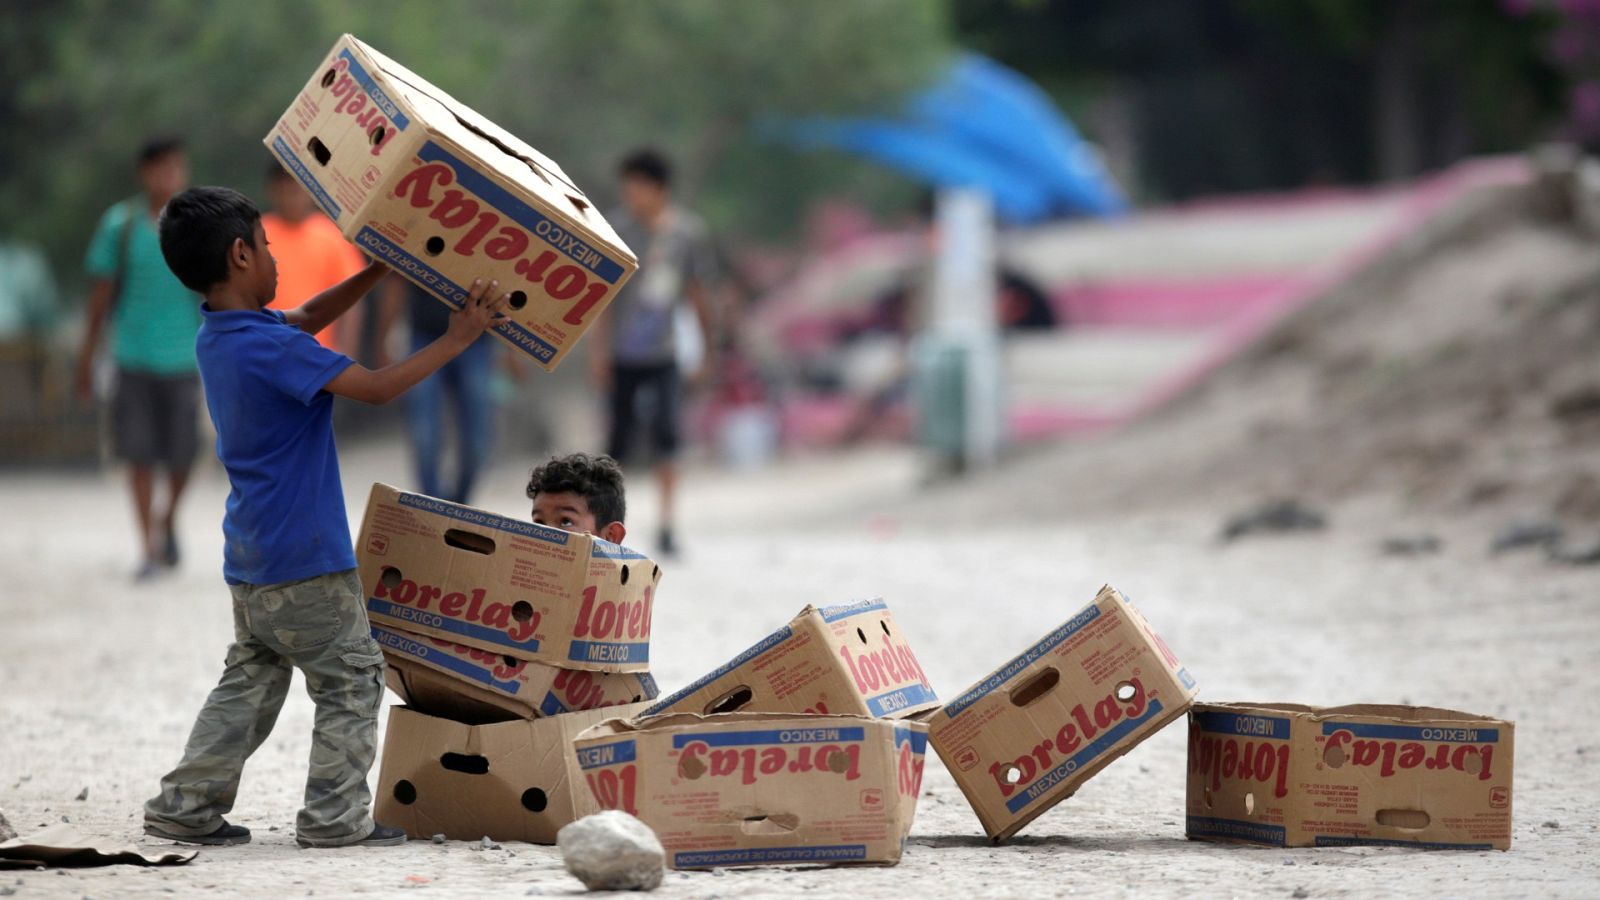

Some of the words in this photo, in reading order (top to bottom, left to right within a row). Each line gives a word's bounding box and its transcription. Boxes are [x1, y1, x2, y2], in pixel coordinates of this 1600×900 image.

[369, 86, 398, 120] MEXICO
[358, 228, 439, 286] EXPORTACION
[394, 164, 609, 326] lorelay
[532, 216, 604, 269] MEXICO
[434, 279, 456, 297] DE
[499, 321, 553, 360] BANANAS
[399, 492, 445, 513] BANANAS
[445, 504, 486, 524] CALIDAD
[486, 515, 501, 527] DE
[500, 518, 567, 544] EXPORTACION
[389, 604, 443, 628] MEXICO
[573, 583, 651, 640] lorel
[376, 631, 429, 658] MEXICO
[588, 644, 629, 661] MEXICO
[839, 633, 929, 696] lorelay
[947, 681, 990, 718] BANANAS
[988, 656, 1026, 689] CALIDAD
[1024, 648, 1039, 662] DE
[1037, 604, 1098, 654] EXPORTACION
[877, 692, 910, 712] MEXICO
[779, 728, 839, 742] MEXICO
[1235, 716, 1274, 735] MEXICO
[1421, 727, 1477, 742] MEXICO
[677, 741, 861, 786] lorelay
[1322, 729, 1494, 781] lorelay
[1026, 757, 1078, 799] MEXICO
[676, 851, 749, 864] EXPORTACION
[750, 851, 764, 860] DE
[766, 849, 811, 860] CALIDAD
[813, 847, 864, 858] BANANAS
